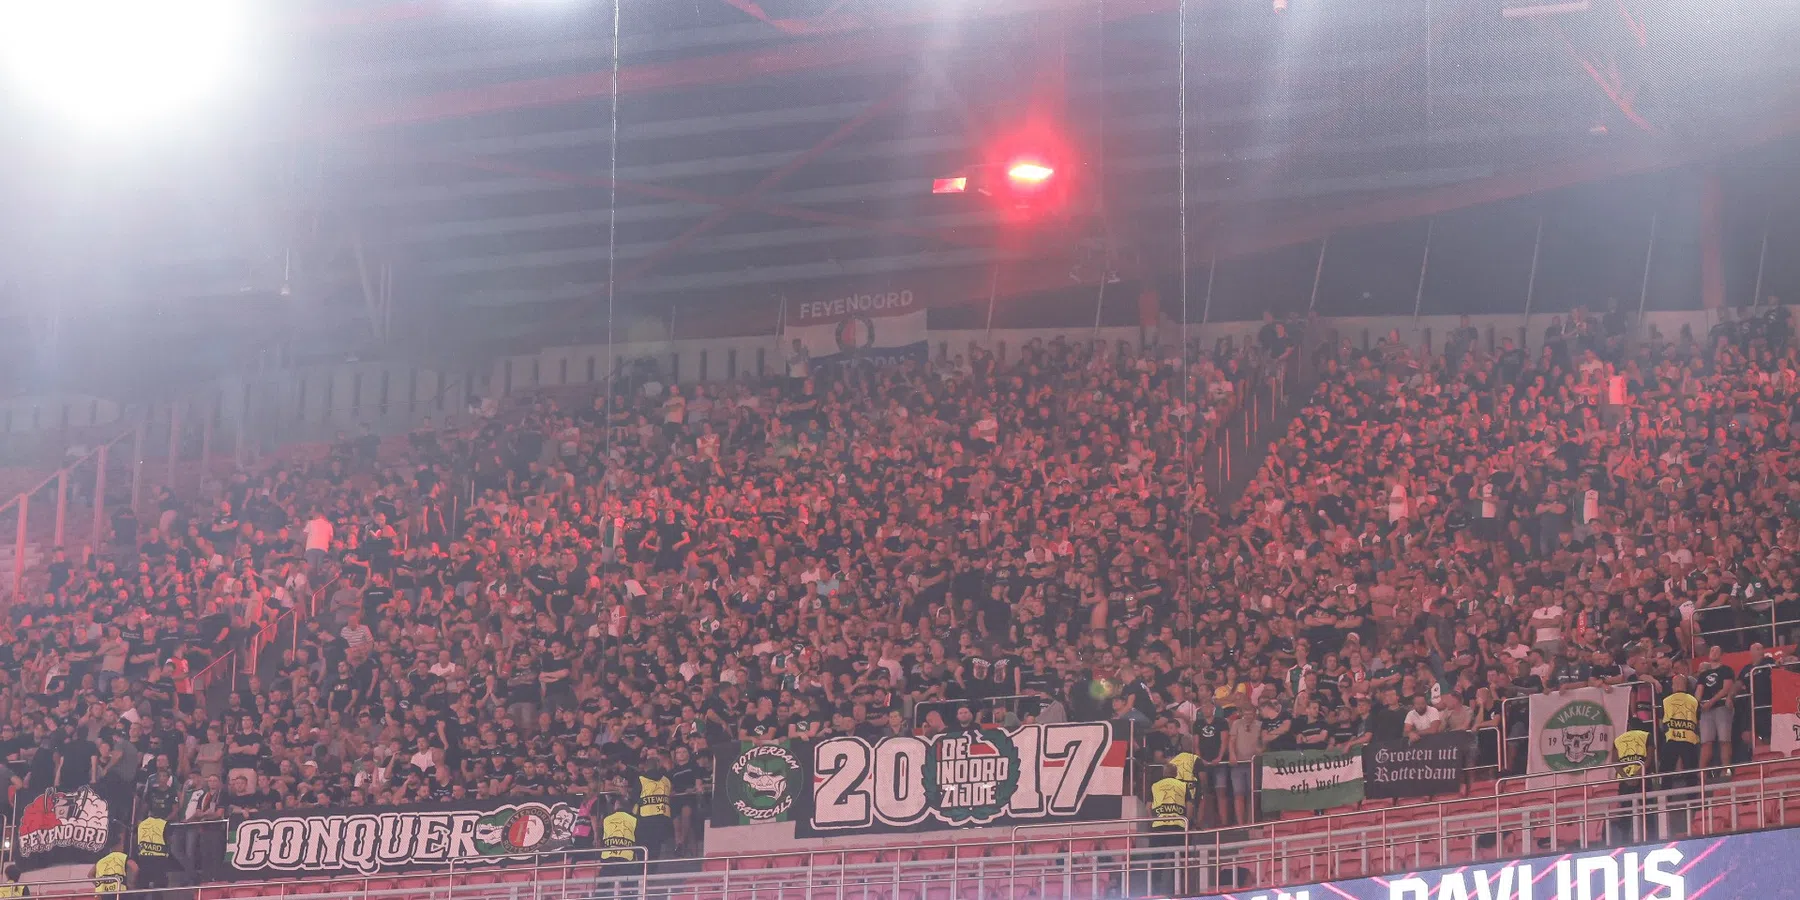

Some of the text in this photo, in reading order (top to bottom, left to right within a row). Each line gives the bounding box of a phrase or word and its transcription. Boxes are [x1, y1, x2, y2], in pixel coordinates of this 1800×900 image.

[800, 289, 913, 319] FEYENOORD
[1557, 705, 1600, 724] VAKKIE Z
[941, 738, 968, 760] DE
[1548, 737, 1558, 746] 19
[732, 746, 799, 775] ROTTERDAM
[1375, 747, 1458, 764] Groeten uit
[941, 757, 1009, 784] NOORD
[1374, 765, 1456, 783] Rotterdam
[940, 781, 997, 808] ZIJDE
[733, 795, 793, 819] RADICALS
[19, 824, 107, 848] FEYENOORD
[236, 812, 482, 872] CONQUER
